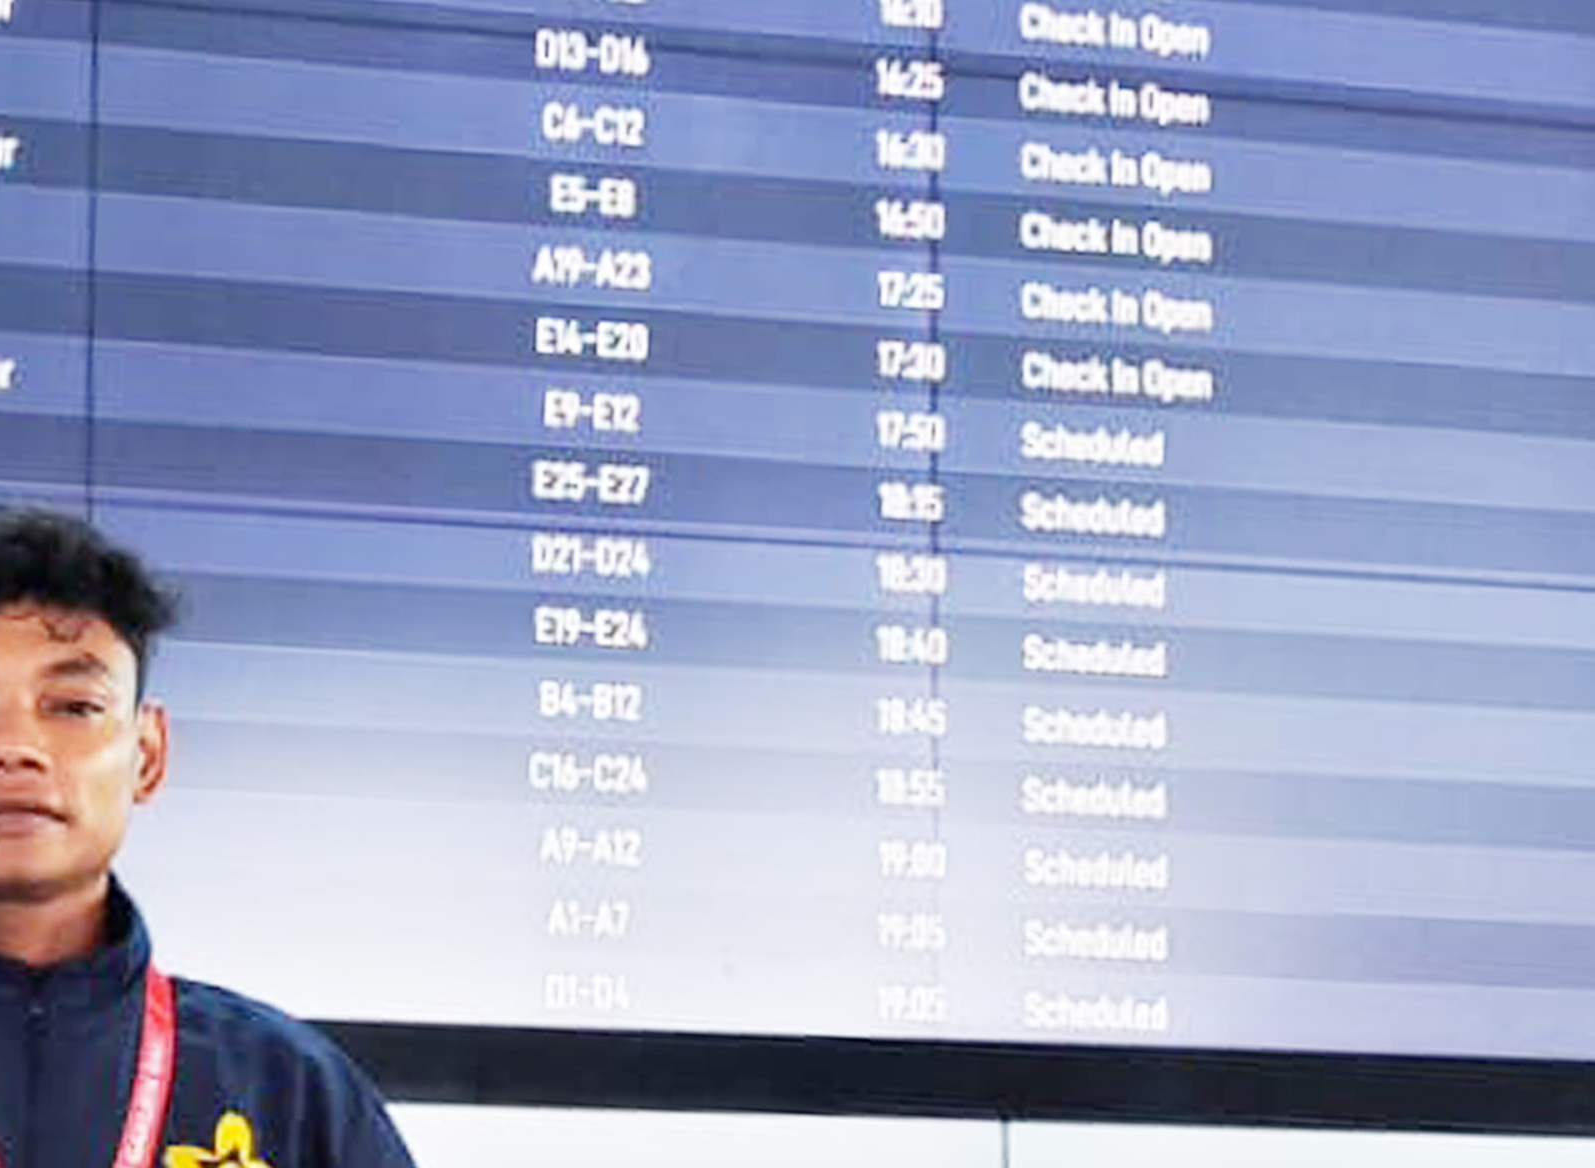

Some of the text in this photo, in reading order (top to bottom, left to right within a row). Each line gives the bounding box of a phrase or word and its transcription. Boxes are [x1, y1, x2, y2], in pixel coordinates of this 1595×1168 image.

[1020, 3, 1105, 46] Check
[1139, 14, 1210, 58] Open
[876, 57, 944, 99] 16:25
[1019, 71, 1106, 115] Check
[1139, 82, 1210, 126] Open
[542, 101, 644, 146] C6-C12
[1021, 142, 1107, 184] Check
[1141, 152, 1212, 196] Open
[550, 174, 636, 218] E5-E8
[1021, 212, 1107, 252] Check
[1142, 221, 1212, 264] Open
[531, 246, 651, 290] A19-A23
[877, 271, 945, 310] 17:25
[1022, 282, 1107, 324] Check
[1142, 290, 1212, 334] Open
[1022, 352, 1108, 393] Check
[1142, 359, 1213, 403] Open
[544, 389, 641, 432] E9-E12
[1021, 421, 1165, 467] Scheduled
[1020, 492, 1166, 537] Scheduled
[1023, 563, 1166, 610] Scheduled
[534, 606, 648, 649] E19-E24
[1022, 634, 1167, 677] Scheduled
[538, 680, 642, 721] B4-B12
[1022, 706, 1167, 749] Scheduled
[529, 752, 648, 794] C16-C24
[1022, 776, 1167, 818] Scheduled
[540, 827, 642, 868] A9-A12
[1024, 848, 1169, 888] Scheduled
[1024, 920, 1168, 961] Scheduled
[1023, 991, 1167, 1031] Scheduled
